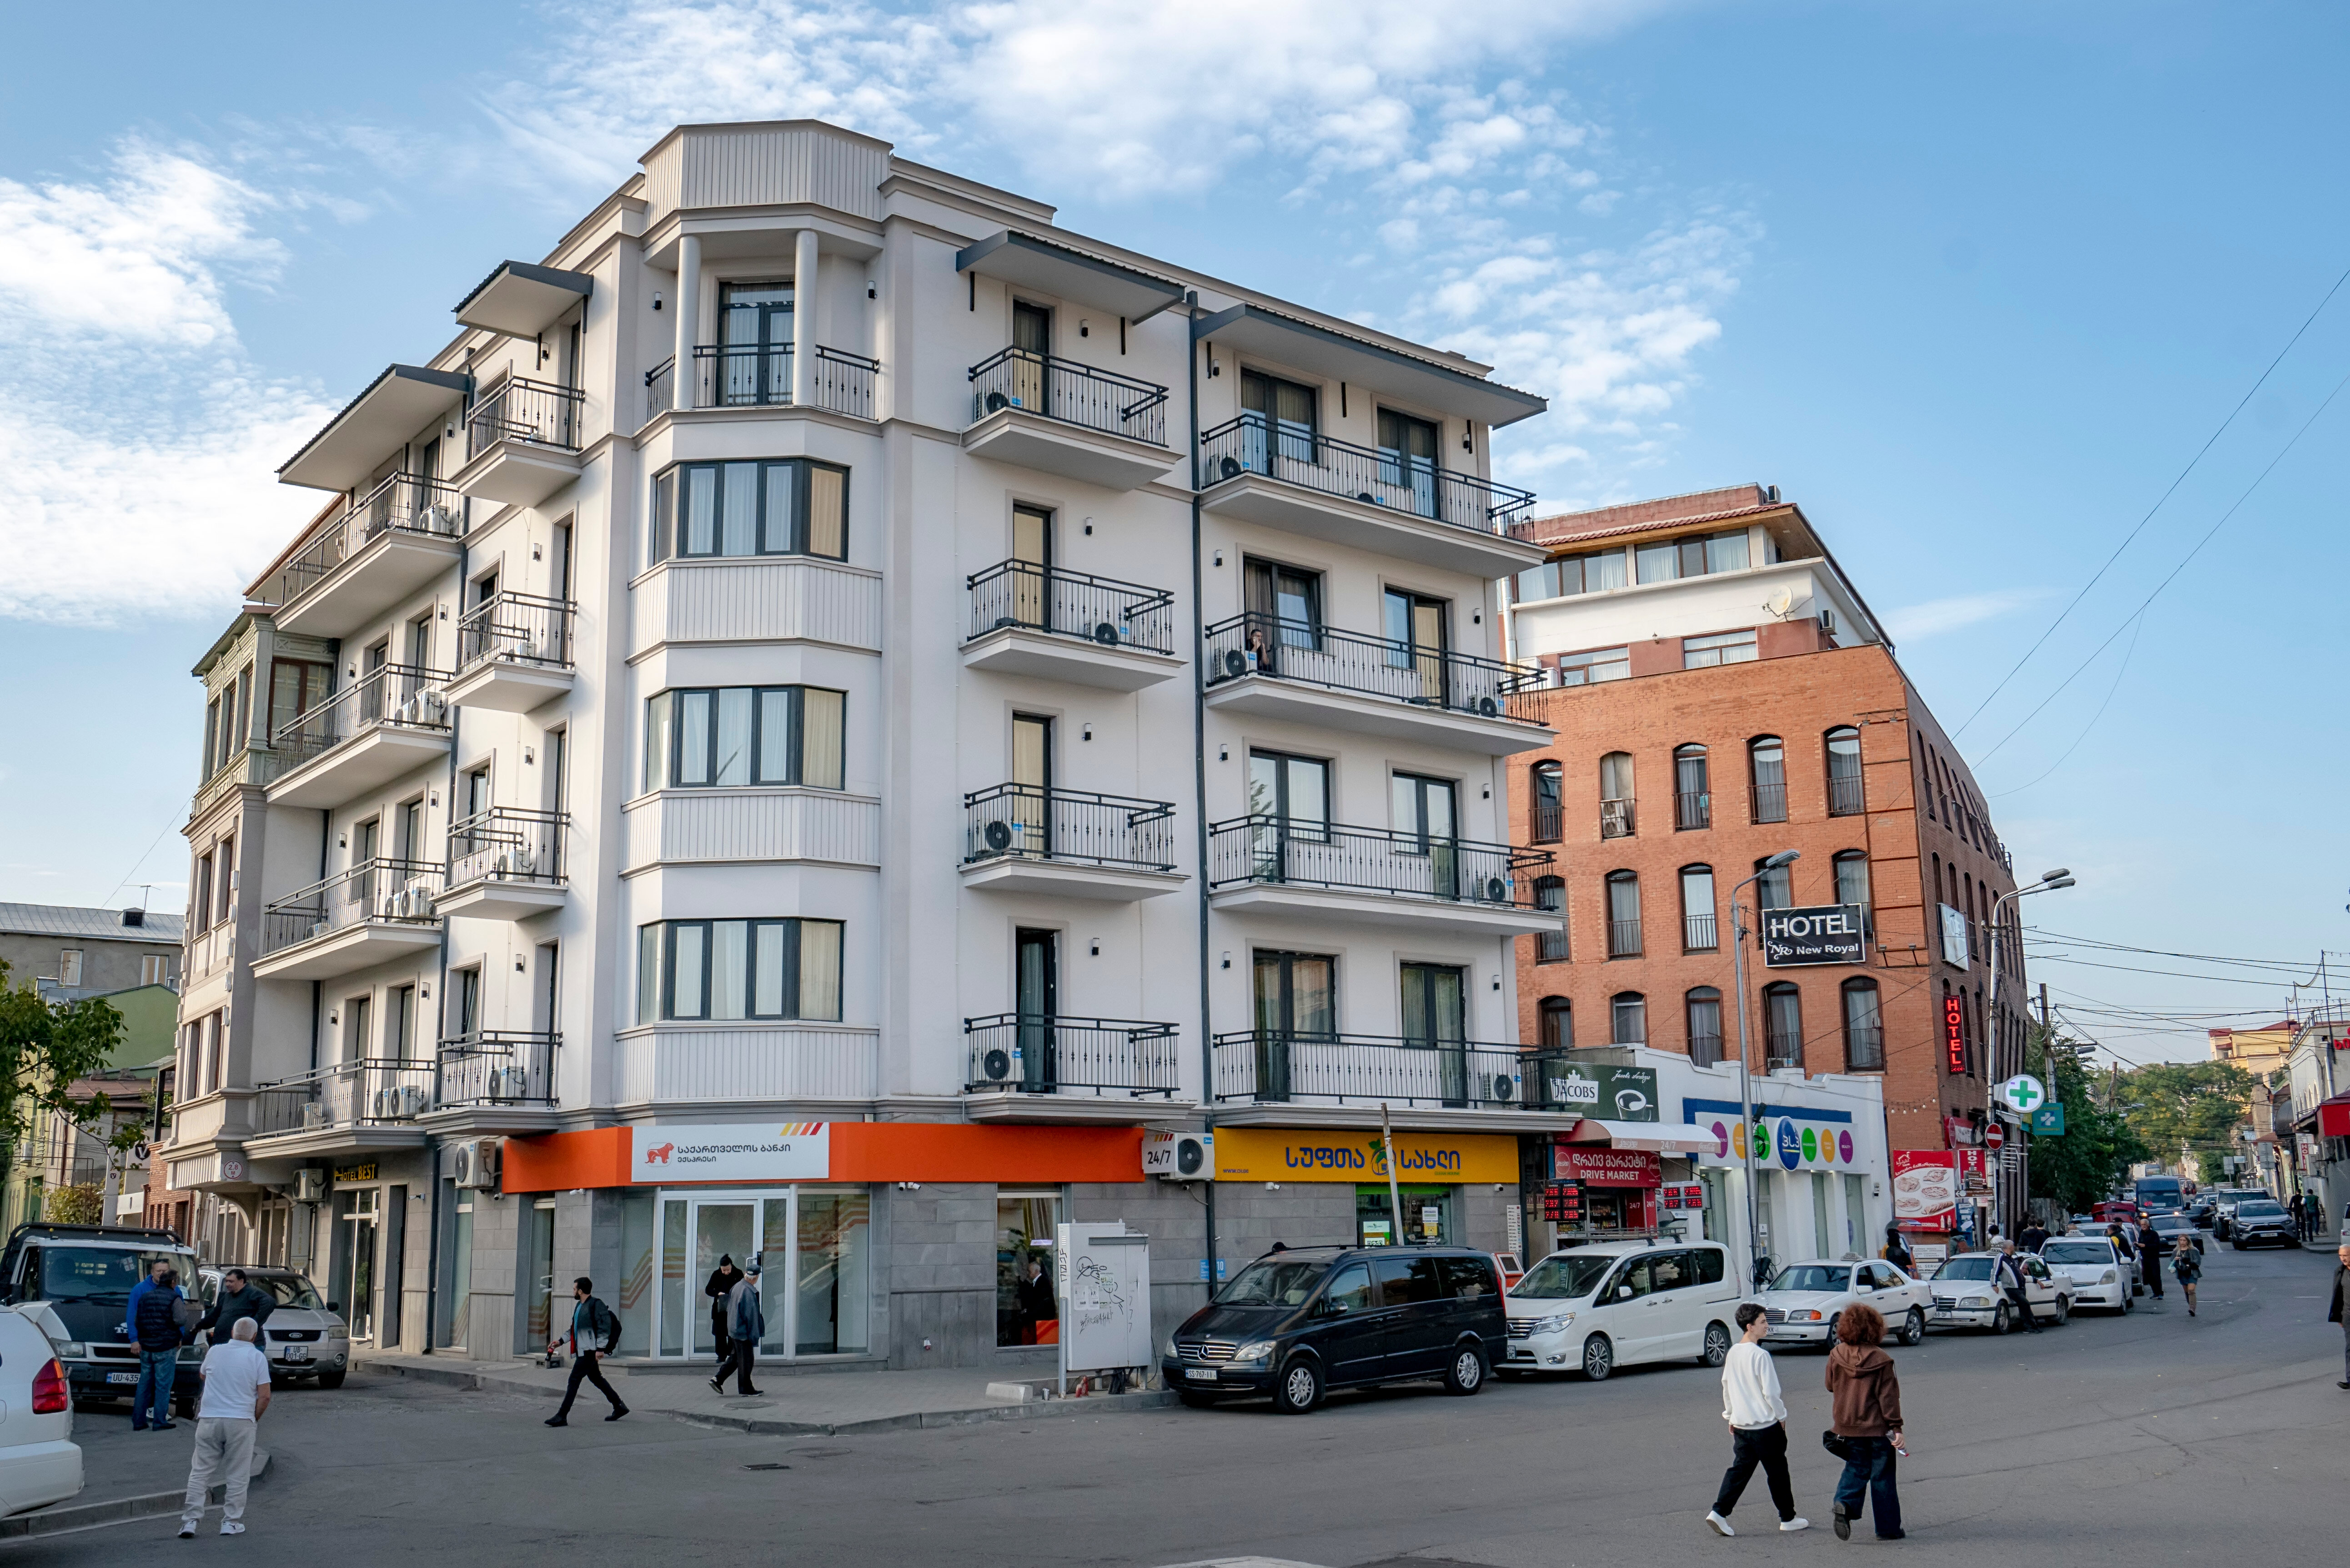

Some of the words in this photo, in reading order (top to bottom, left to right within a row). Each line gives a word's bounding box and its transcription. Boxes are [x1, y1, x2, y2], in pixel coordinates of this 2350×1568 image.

[1771, 914, 1857, 938] HOTEL
[1797, 946, 1822, 955] New
[1825, 943, 1858, 954] Royal
[1947, 1000, 1962, 1064] HOTEL
[1554, 1085, 1595, 1099] JACOBS
[138, 1146, 148, 1158] V
[678, 1145, 758, 1153] საქართველოს
[1661, 1141, 1676, 1150] 24/7
[1147, 1150, 1171, 1165] 24/7
[1286, 1147, 1365, 1168] სუფთა
[1401, 1149, 1461, 1169] სახლი
[1572, 1153, 1603, 1167] დრაივ
[1606, 1155, 1646, 1168] მარკეტი
[358, 1164, 376, 1180] BEST
[1580, 1170, 1604, 1180] DRIVE
[1607, 1171, 1639, 1180] MARKET
[1216, 1261, 1224, 1270] 10
